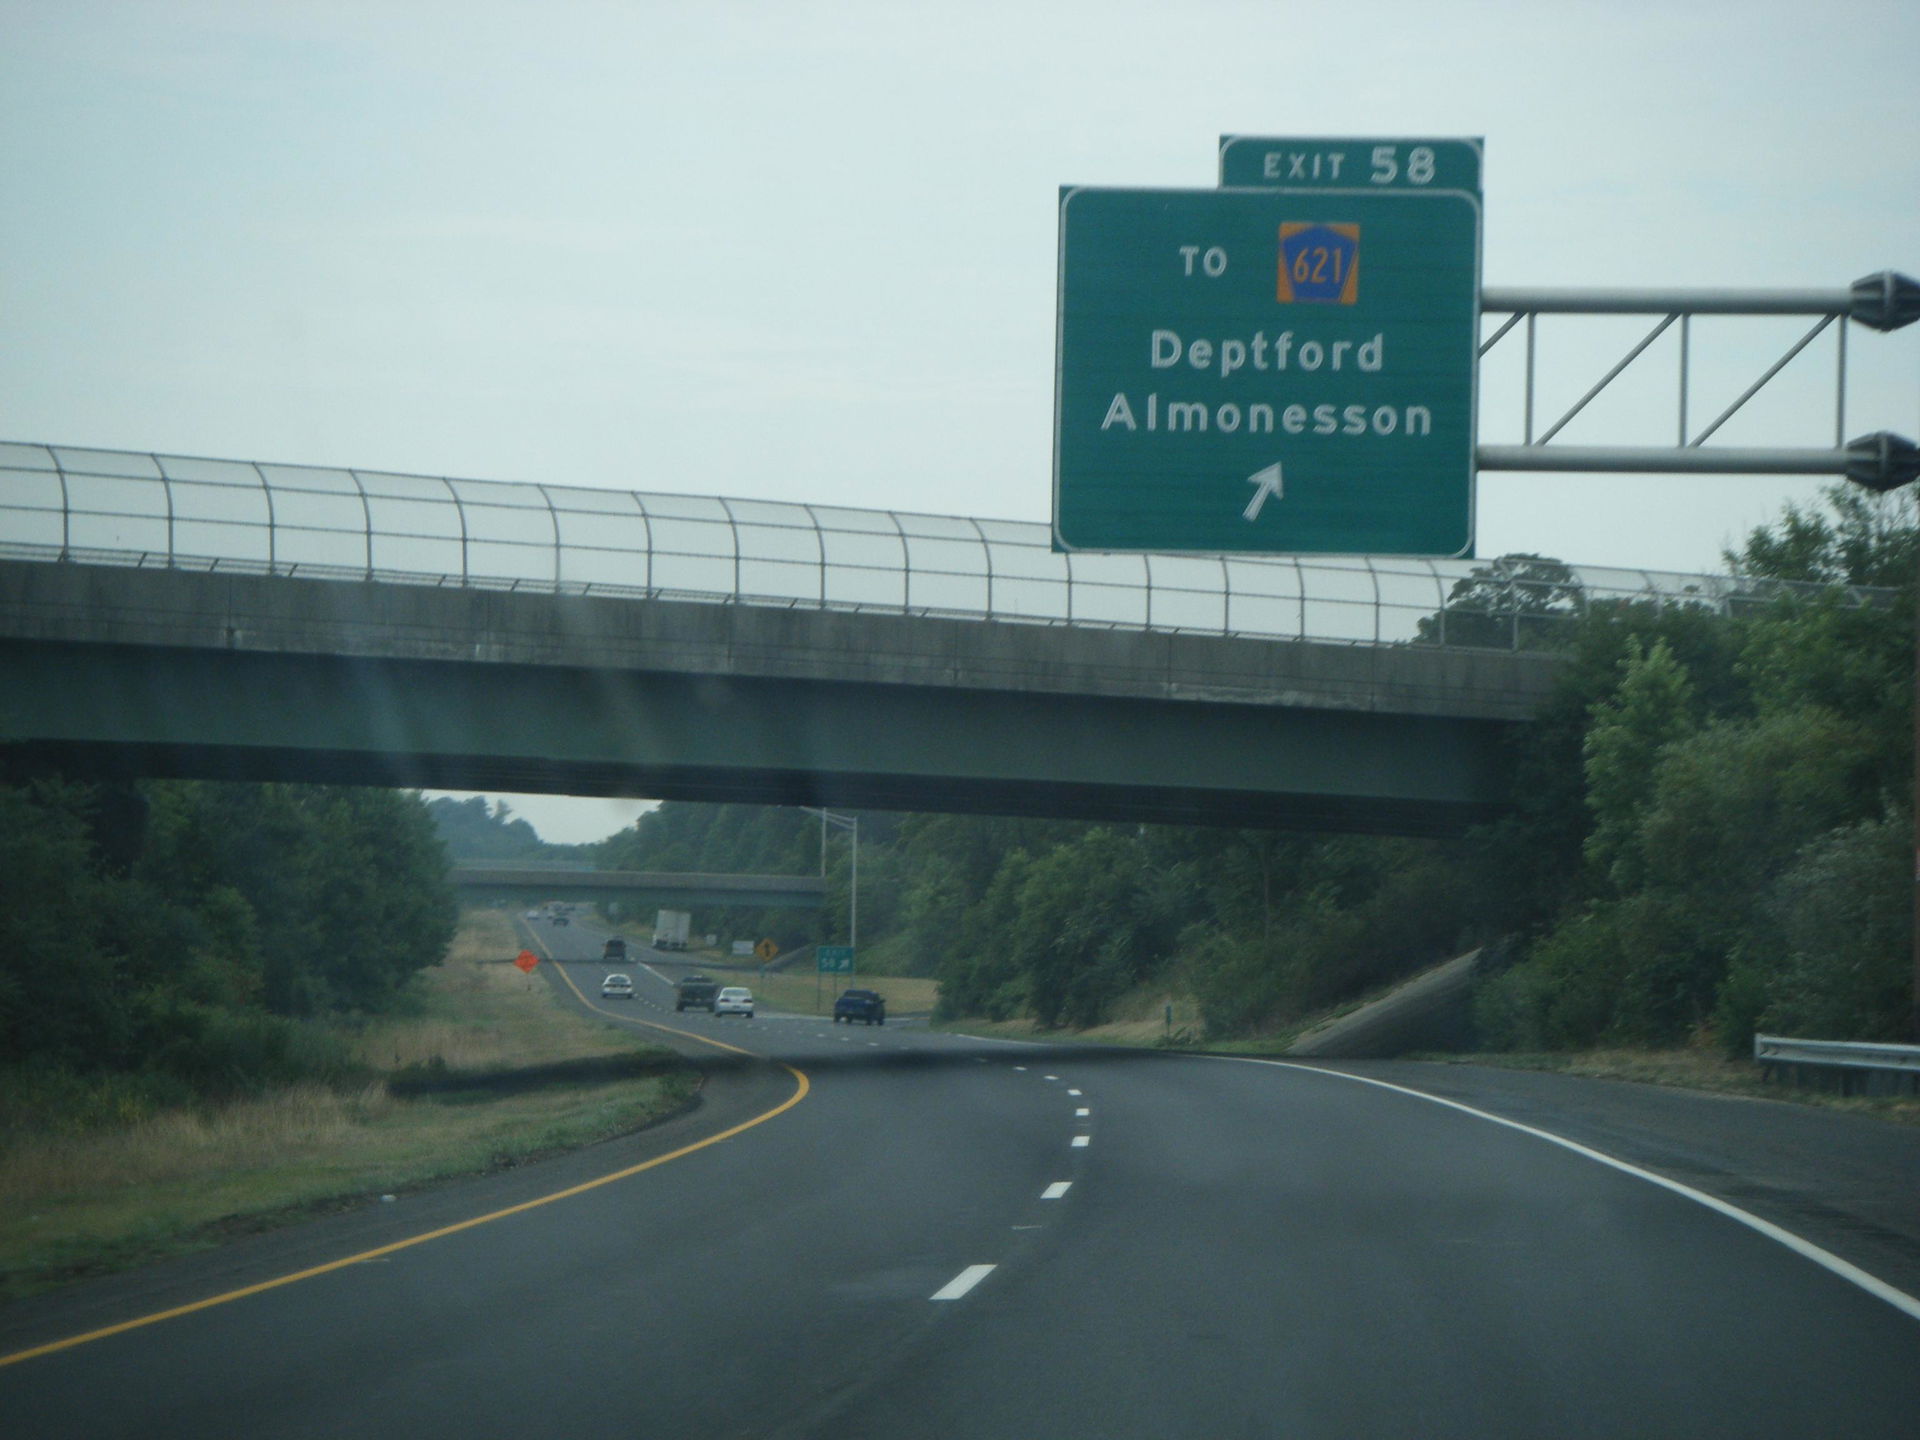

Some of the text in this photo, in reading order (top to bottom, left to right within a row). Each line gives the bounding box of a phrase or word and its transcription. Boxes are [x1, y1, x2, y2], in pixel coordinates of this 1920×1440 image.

[1263, 147, 1436, 185] EXIT 58
[1179, 246, 1342, 284] TO 621
[1151, 329, 1385, 378] Deptford
[1101, 392, 1432, 437] Almonesson
